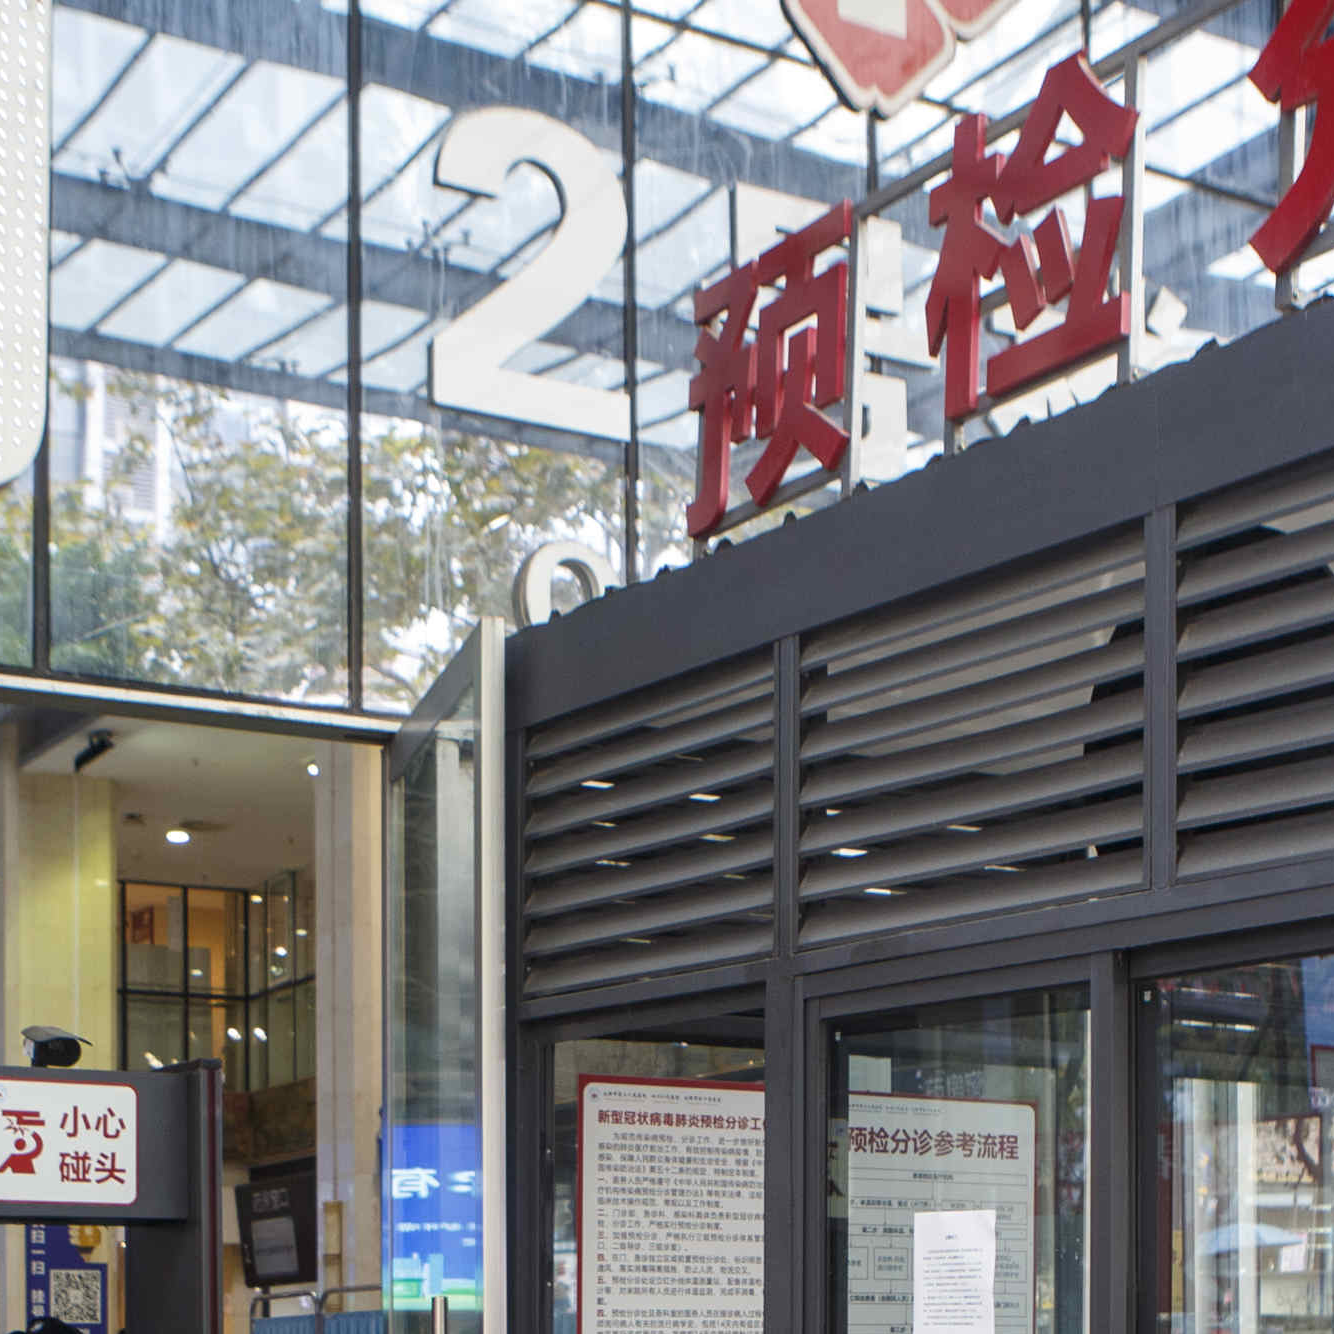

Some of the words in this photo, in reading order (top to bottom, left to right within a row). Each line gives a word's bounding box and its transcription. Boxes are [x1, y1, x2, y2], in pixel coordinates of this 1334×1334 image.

[59, 1105, 126, 1140] 小心
[598, 1110, 765, 1131] 新型冠状病毒肺炎预检分诊工
[58, 1150, 126, 1185] 碰头
